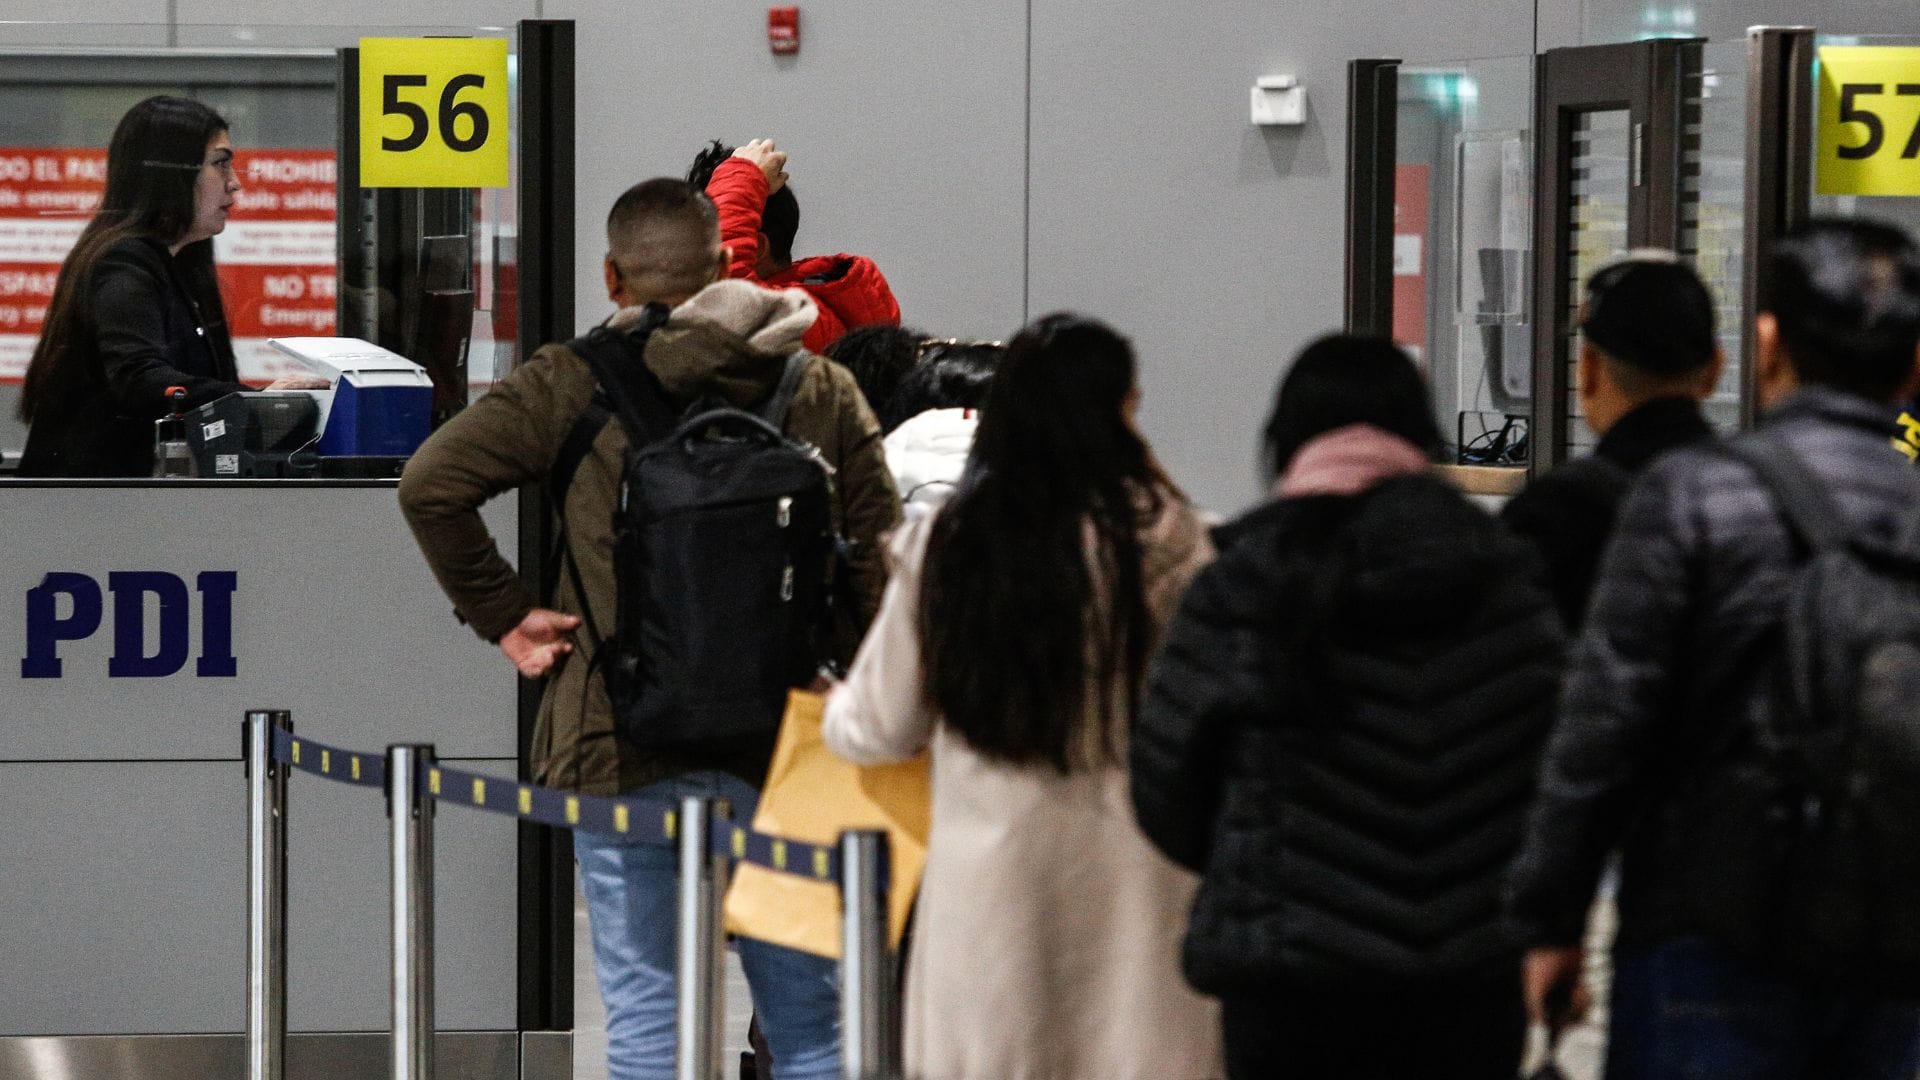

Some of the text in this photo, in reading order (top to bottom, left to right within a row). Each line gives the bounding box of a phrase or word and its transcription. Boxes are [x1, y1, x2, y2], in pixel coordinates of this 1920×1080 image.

[381, 73, 490, 153] 56
[1836, 83, 1920, 160] 57
[263, 274, 305, 299] NO
[21, 570, 238, 679] PDI
